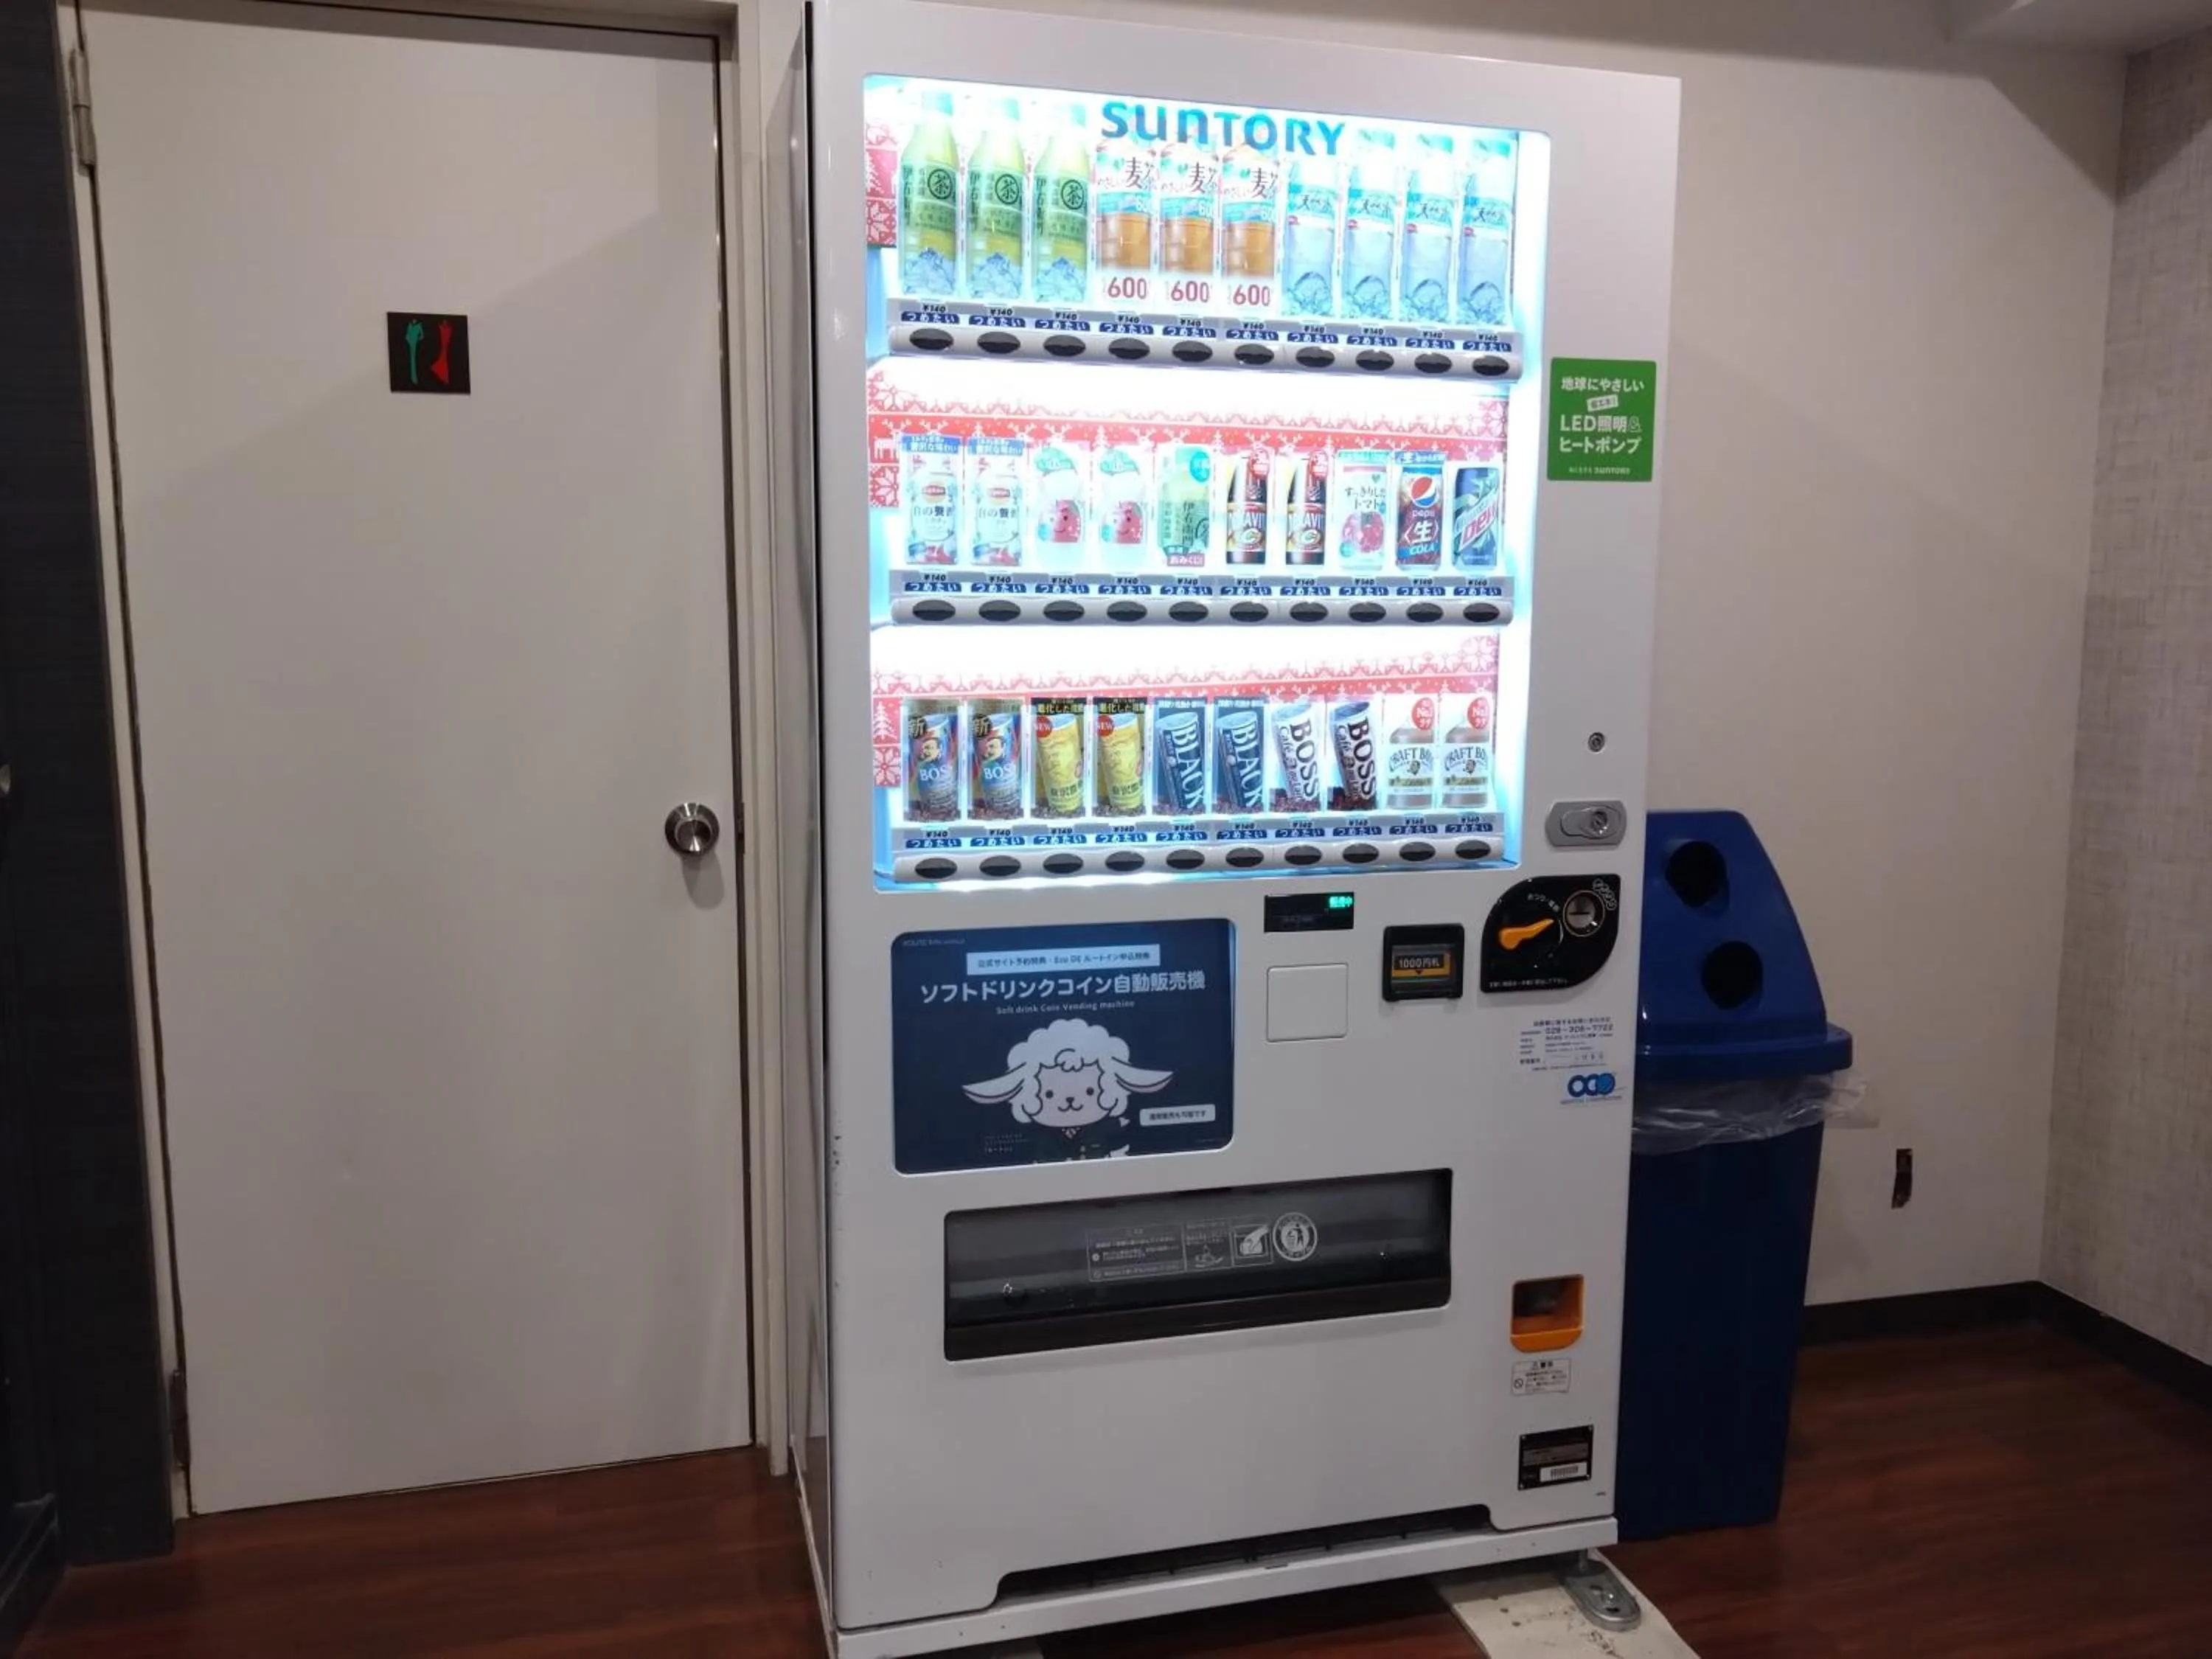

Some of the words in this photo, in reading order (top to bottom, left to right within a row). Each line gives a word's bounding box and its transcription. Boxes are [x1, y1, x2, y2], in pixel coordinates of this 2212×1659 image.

[1101, 101, 1346, 156] SUNTORY
[932, 172, 950, 196] 茶
[999, 177, 1017, 201] 茶
[1065, 182, 1082, 207] 茶
[1108, 277, 1147, 299] 600
[1171, 280, 1209, 302] 600
[1233, 285, 1270, 306] 600
[905, 310, 956, 324] つめたい
[973, 315, 1023, 327] つめたい
[1039, 319, 1087, 331] つめたい
[1102, 322, 1150, 334] つめたい
[1166, 325, 1214, 338] つめたい
[1229, 329, 1276, 341] つめたい
[1291, 333, 1335, 344] つめたい
[1351, 335, 1394, 347] つめたい
[1409, 338, 1452, 349] つめたい
[1467, 341, 1509, 352] つめたい
[1561, 376, 1645, 392] 地球にやさしい
[1559, 436, 1642, 454] ヒートポンプ
[1413, 521, 1435, 543] 生
[1231, 721, 1263, 807] BLACK
[1290, 718, 1318, 797] BOSS
[1348, 716, 1377, 795] BOSS
[919, 765, 950, 781] BOS
[984, 763, 1015, 779] BOS
[1171, 723, 1203, 809] BLACK
[921, 970, 1206, 1004] ソフトドリンクコイン自動販売機
[996, 1006, 1015, 1015] Soft
[1016, 1004, 1038, 1013] drink
[1062, 1001, 1097, 1011] Vending
[1099, 1000, 1135, 1009] machine
